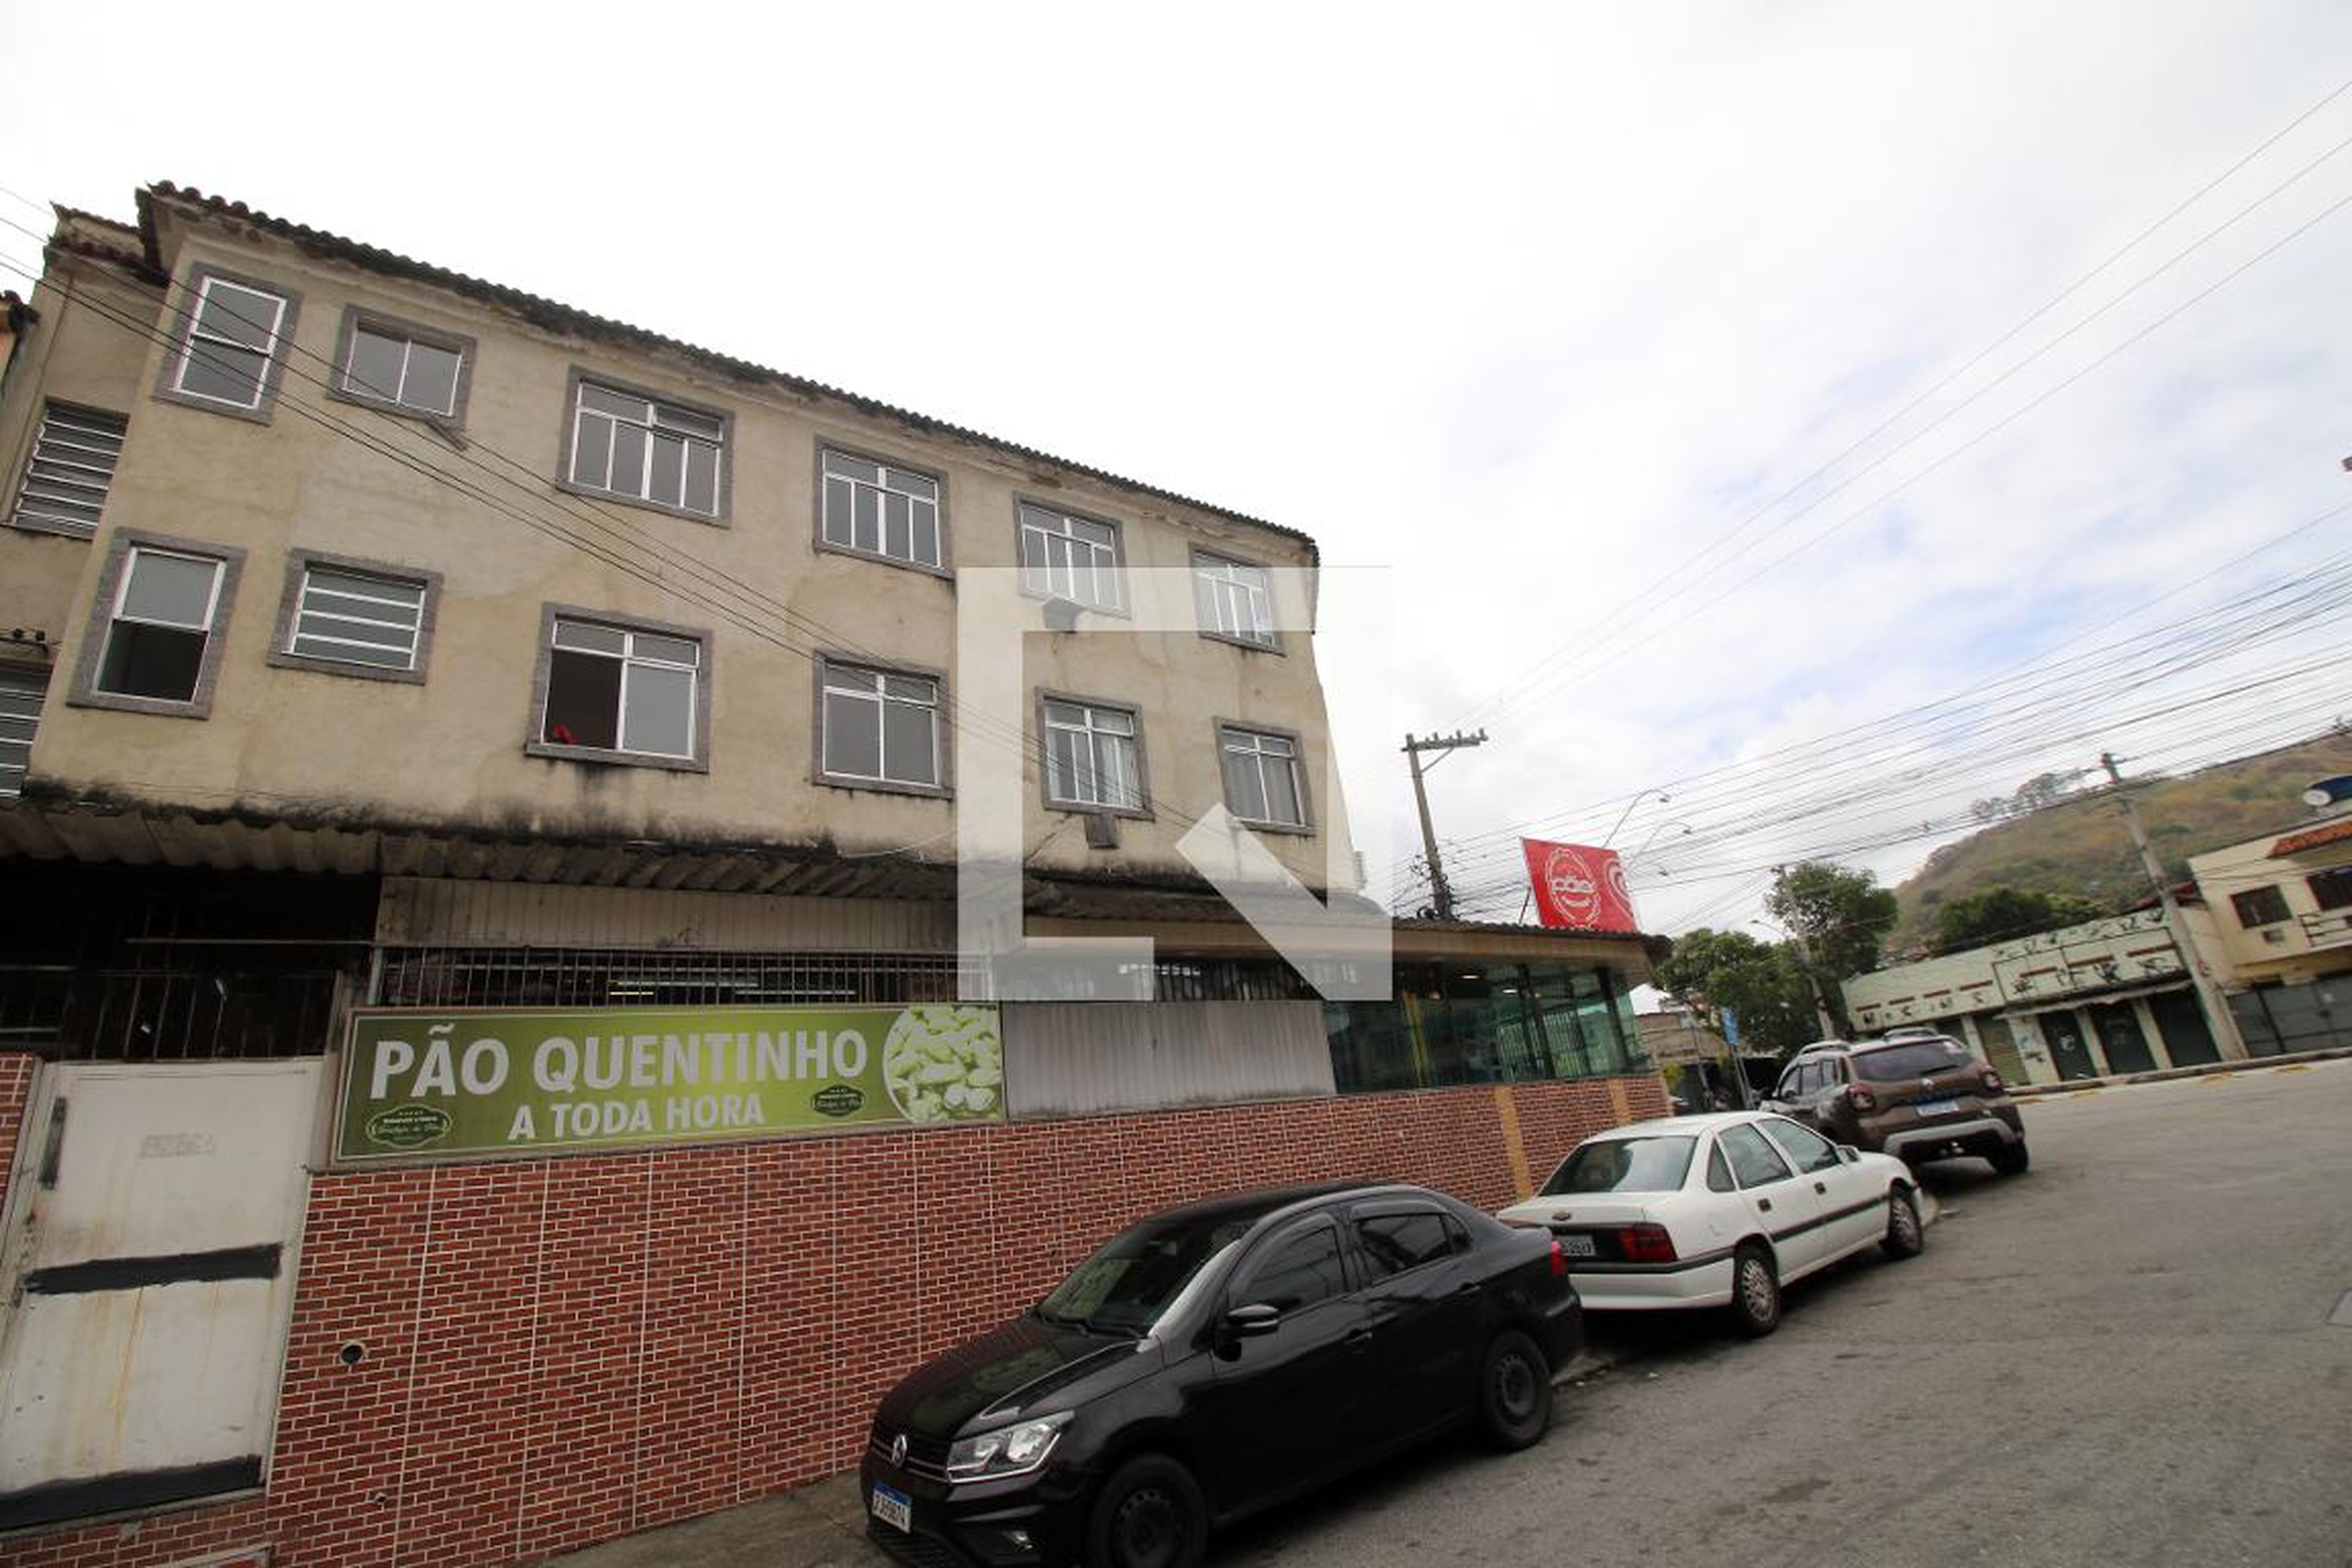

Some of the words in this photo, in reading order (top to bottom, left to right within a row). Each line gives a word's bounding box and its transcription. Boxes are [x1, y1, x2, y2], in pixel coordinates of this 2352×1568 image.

[370, 1023, 509, 1099] PÃO
[532, 1028, 867, 1093] QUENTINHO
[508, 1105, 536, 1140] A
[549, 1099, 652, 1139] TODA
[666, 1094, 766, 1129] HORA
